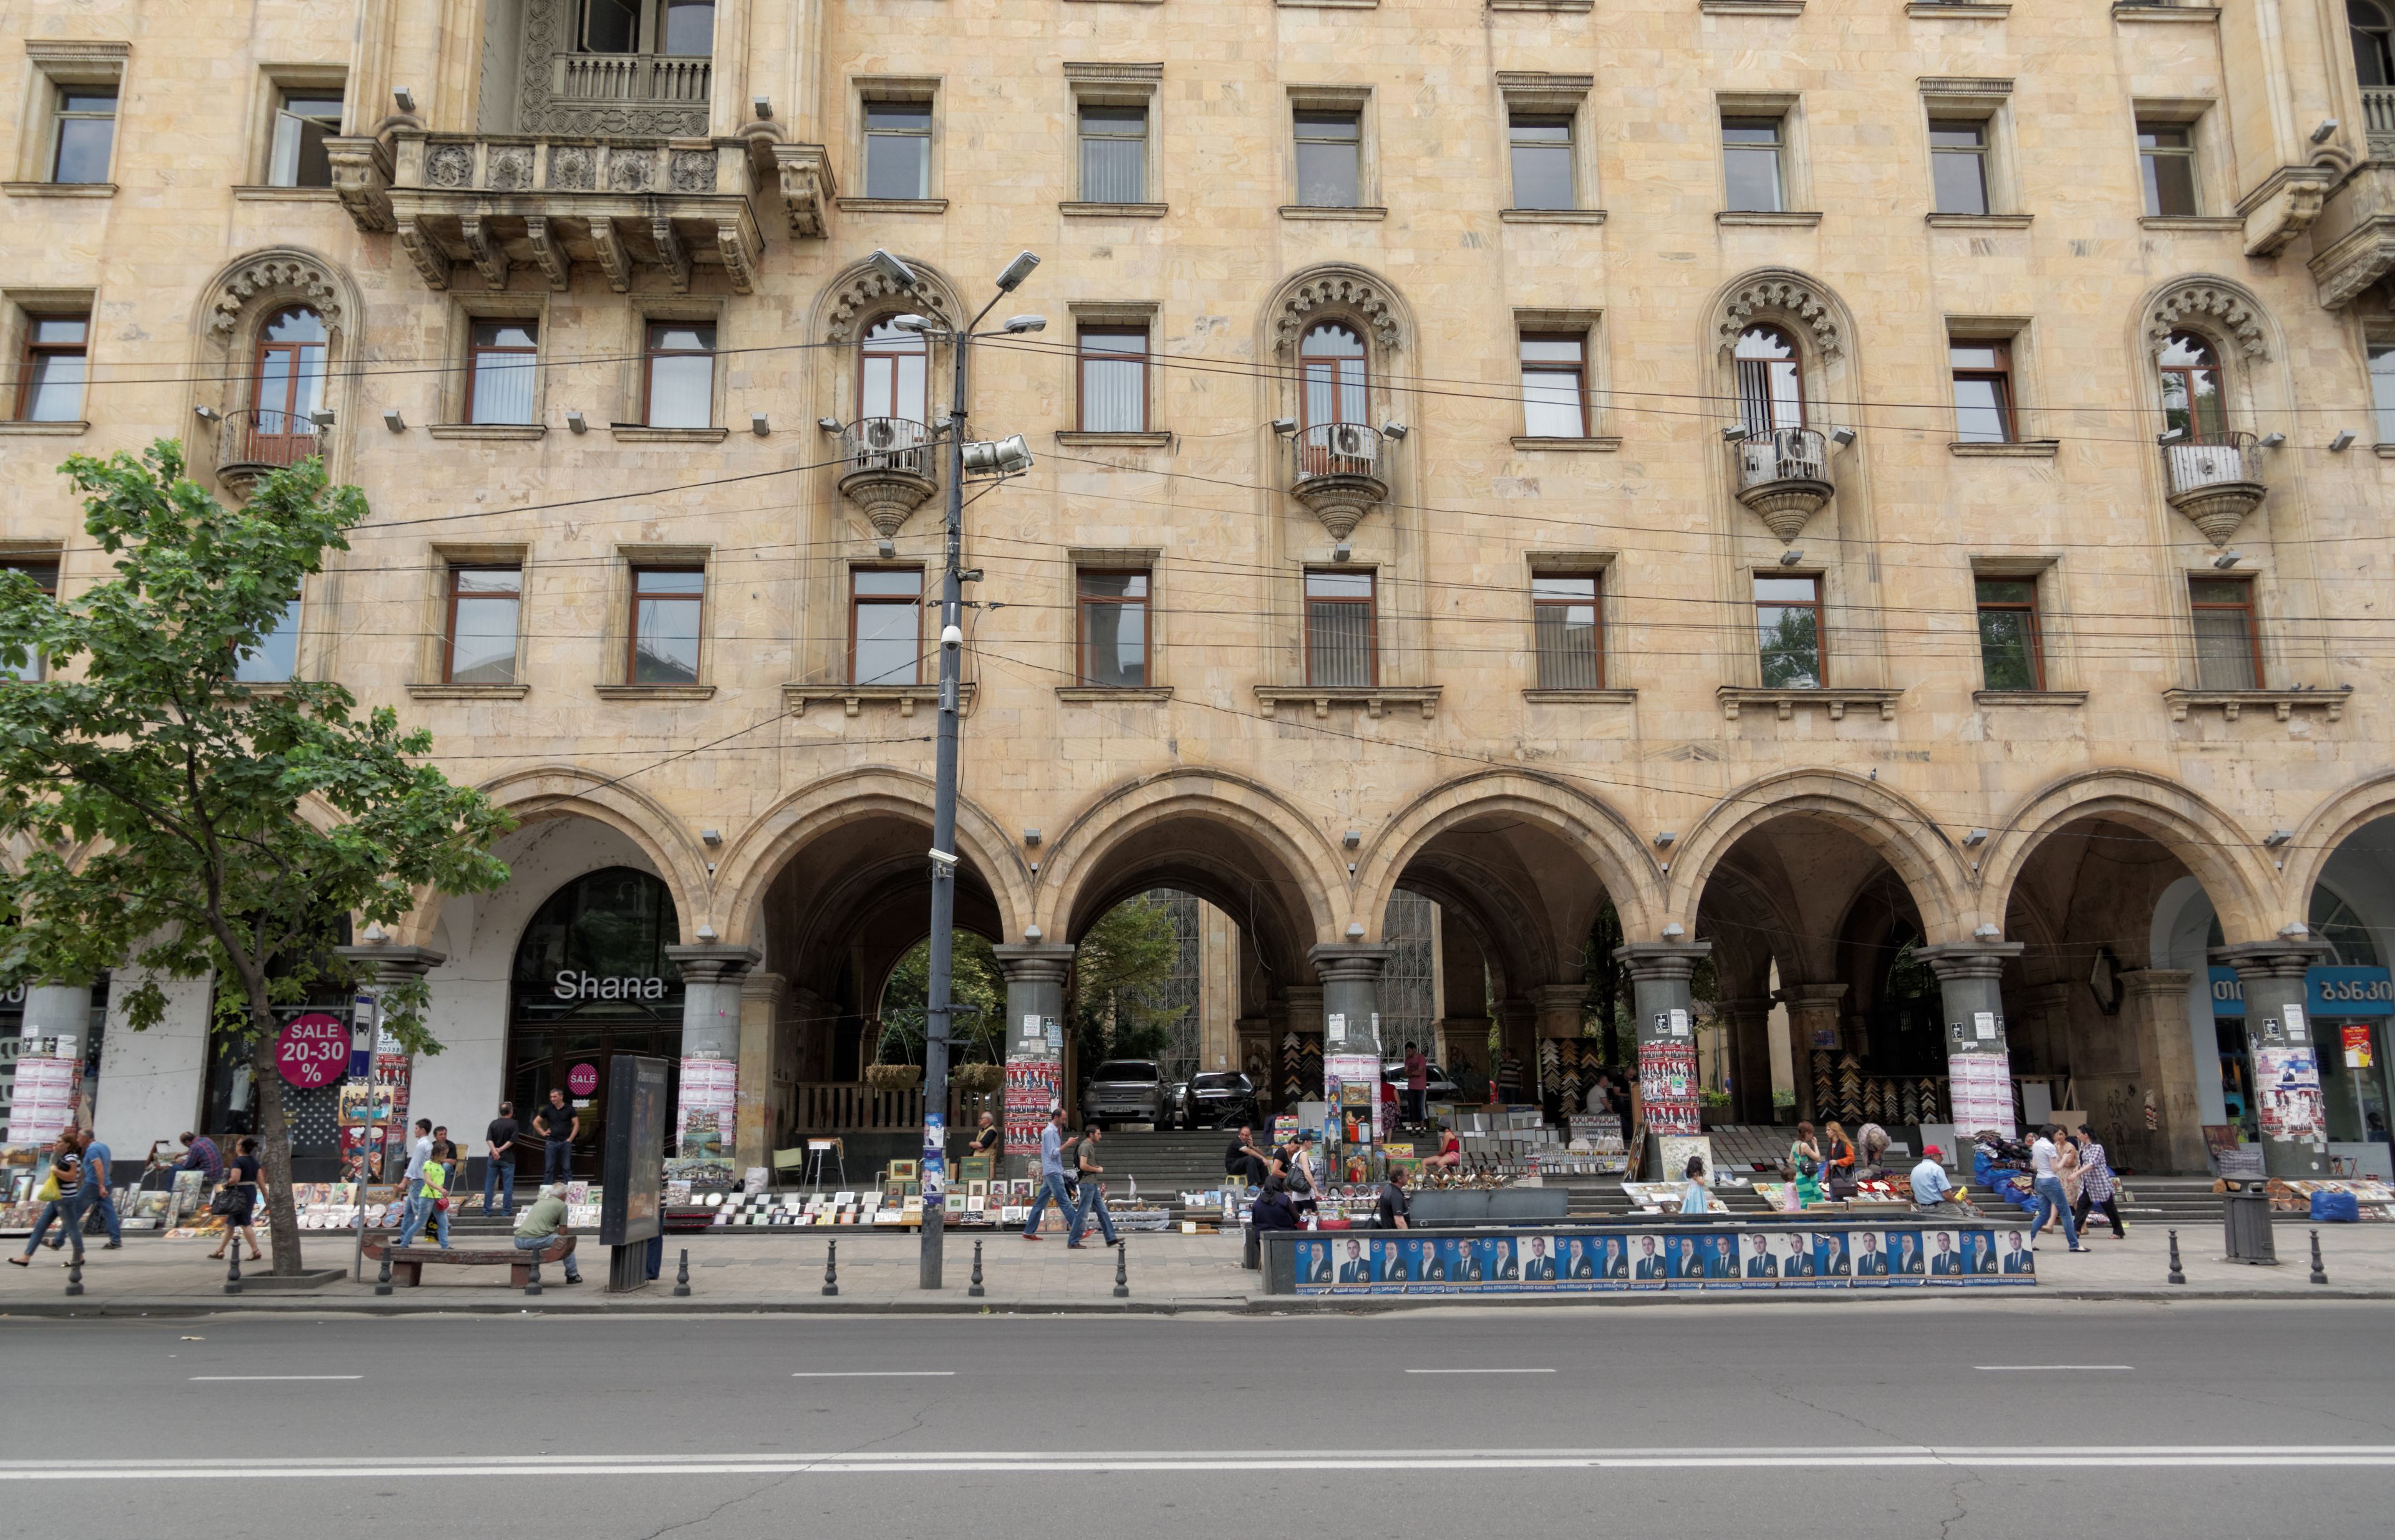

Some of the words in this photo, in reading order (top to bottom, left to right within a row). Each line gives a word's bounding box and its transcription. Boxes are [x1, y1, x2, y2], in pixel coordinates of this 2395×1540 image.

[554, 970, 663, 999] Shana
[2320, 980, 2394, 1000] ბანკი
[291, 1024, 339, 1039] SALE
[282, 1041, 344, 1062] 20-30
[301, 1062, 322, 1082] %
[570, 1075, 596, 1083] SALE
